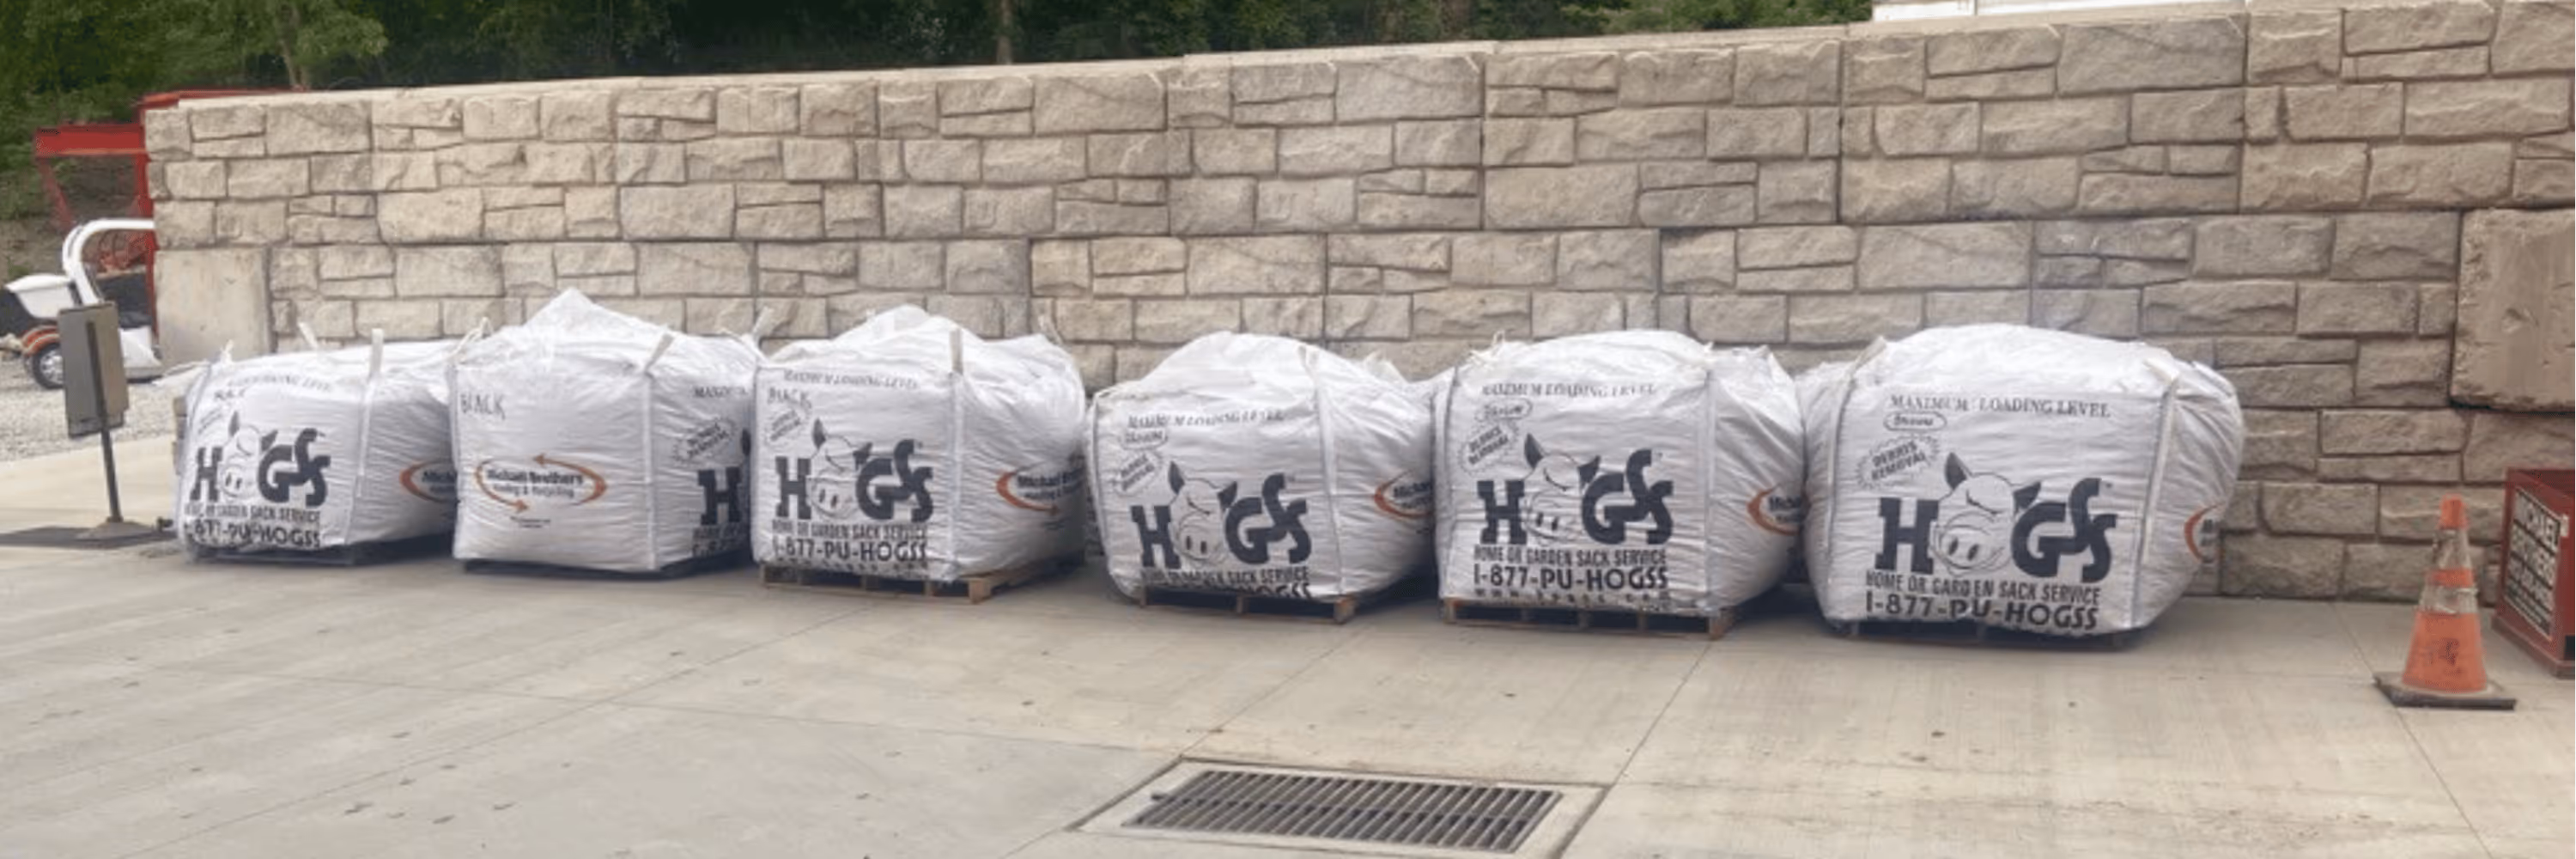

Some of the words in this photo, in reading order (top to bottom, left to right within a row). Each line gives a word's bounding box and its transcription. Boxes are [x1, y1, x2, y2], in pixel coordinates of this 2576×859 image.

[1891, 394, 1968, 411] MAXIMUM
[1980, 397, 2053, 414] LOADING
[2057, 400, 2111, 418] LEVEL
[1527, 547, 1573, 566] GARDEN
[1577, 549, 1610, 567] SACK
[1614, 549, 1668, 567] SERVICE
[1474, 563, 1668, 590] 1-877-PU-HOGSS
[1866, 570, 1904, 592] HOME
[1908, 575, 1927, 594] OR
[1932, 577, 1995, 599] GARDEN
[1999, 580, 2038, 600] SACK
[2042, 583, 2102, 606] SERVICE
[1866, 590, 2099, 631] 1-877-PU-HOGSS
